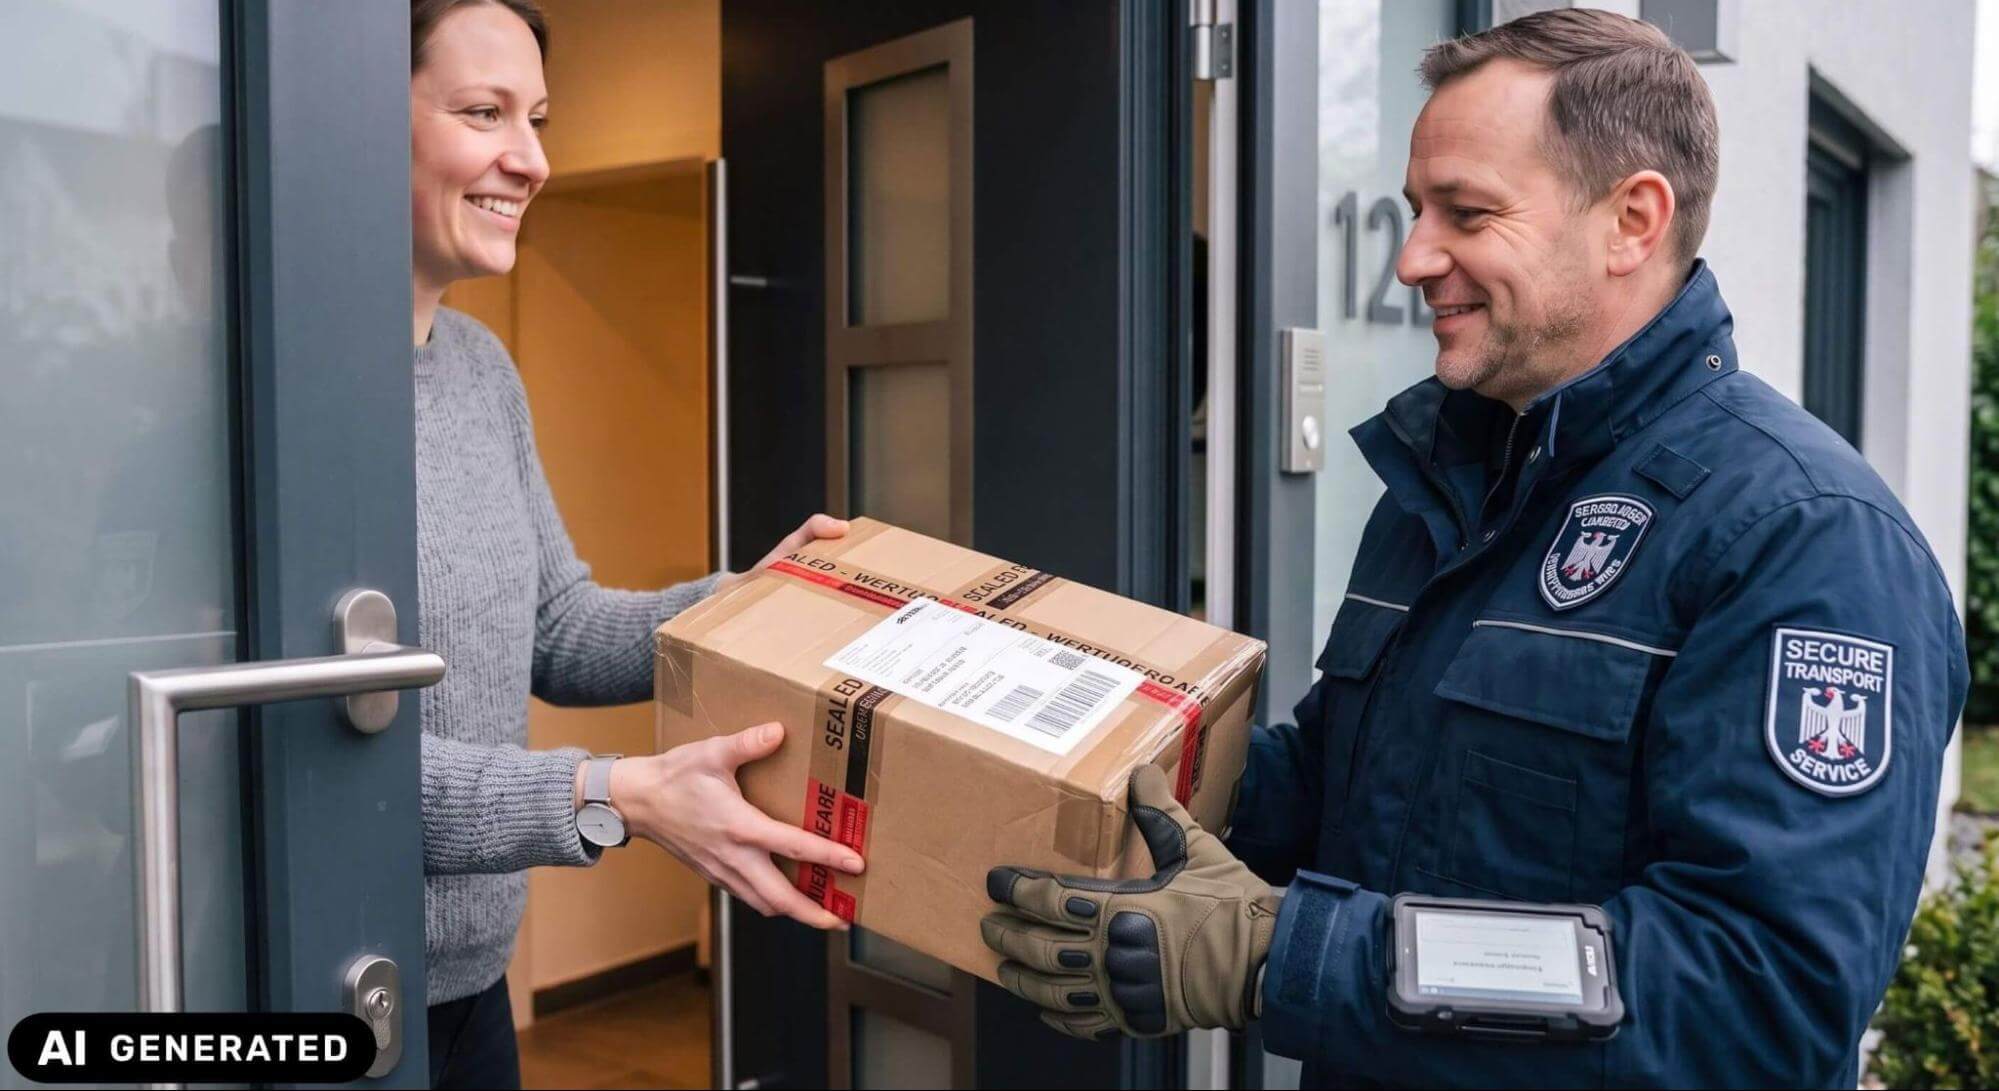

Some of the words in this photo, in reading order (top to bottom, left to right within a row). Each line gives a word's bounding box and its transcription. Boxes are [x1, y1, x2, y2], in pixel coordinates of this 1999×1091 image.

[1335, 190, 1435, 328] 12
[963, 570, 1020, 602] SEALED
[1785, 639, 1885, 673] SECURE
[1784, 661, 1884, 693] TRANSPORT
[825, 678, 863, 750] SEALED
[1789, 748, 1872, 782] SERVICE
